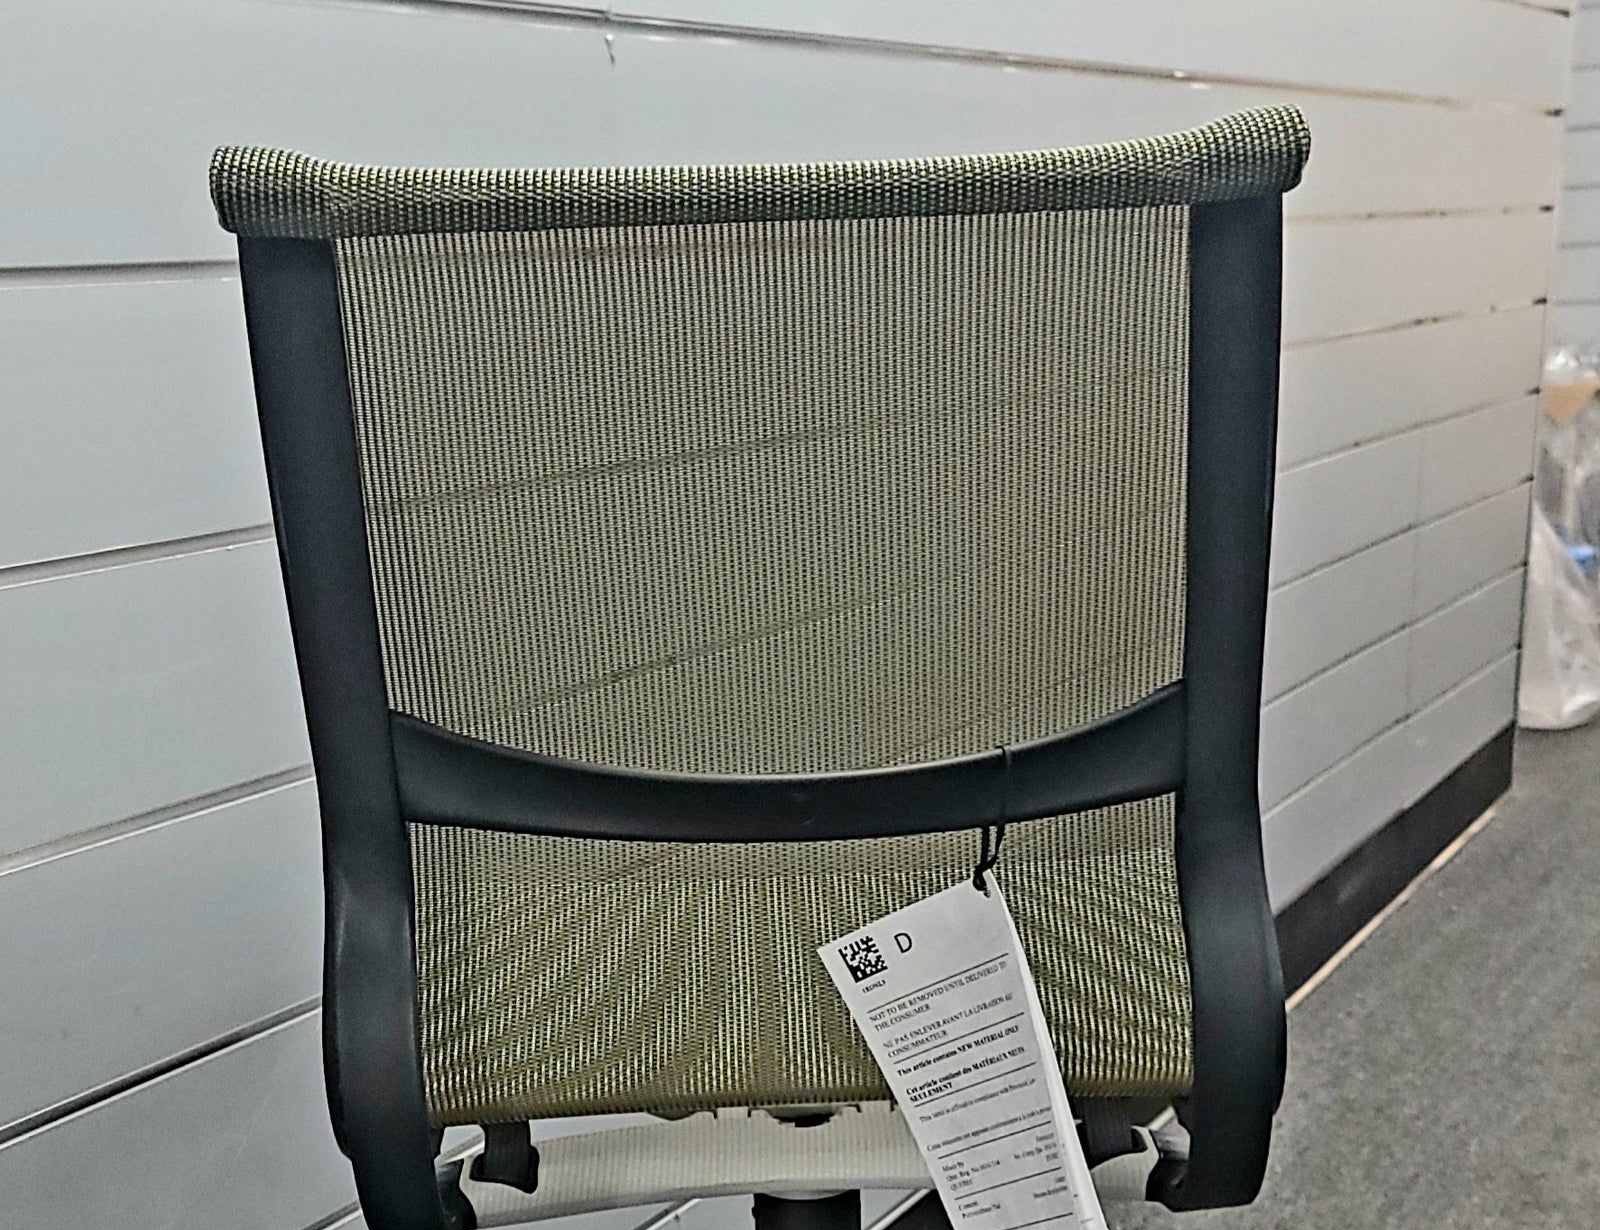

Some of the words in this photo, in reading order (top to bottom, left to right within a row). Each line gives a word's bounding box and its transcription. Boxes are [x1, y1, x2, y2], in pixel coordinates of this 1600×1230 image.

[893, 932, 913, 954] D
[869, 1011, 886, 1021] NOT
[886, 1006, 897, 1016] TO
[908, 987, 944, 1006] REMOVED
[943, 979, 965, 992] UNTIL
[874, 1021, 890, 1032] THE
[890, 1003, 931, 1025] CONSUMER
[894, 1034, 909, 1045] PAS
[909, 1020, 942, 1038] ENLEVER
[897, 1067, 912, 1076] This
[913, 1059, 932, 1071] article
[957, 1042, 973, 1052] NEW
[973, 1030, 1005, 1047] MATERIAL
[906, 1086, 918, 1096] Cet
[919, 1079, 938, 1091] article
[908, 1081, 953, 1103] SEULEMENT
